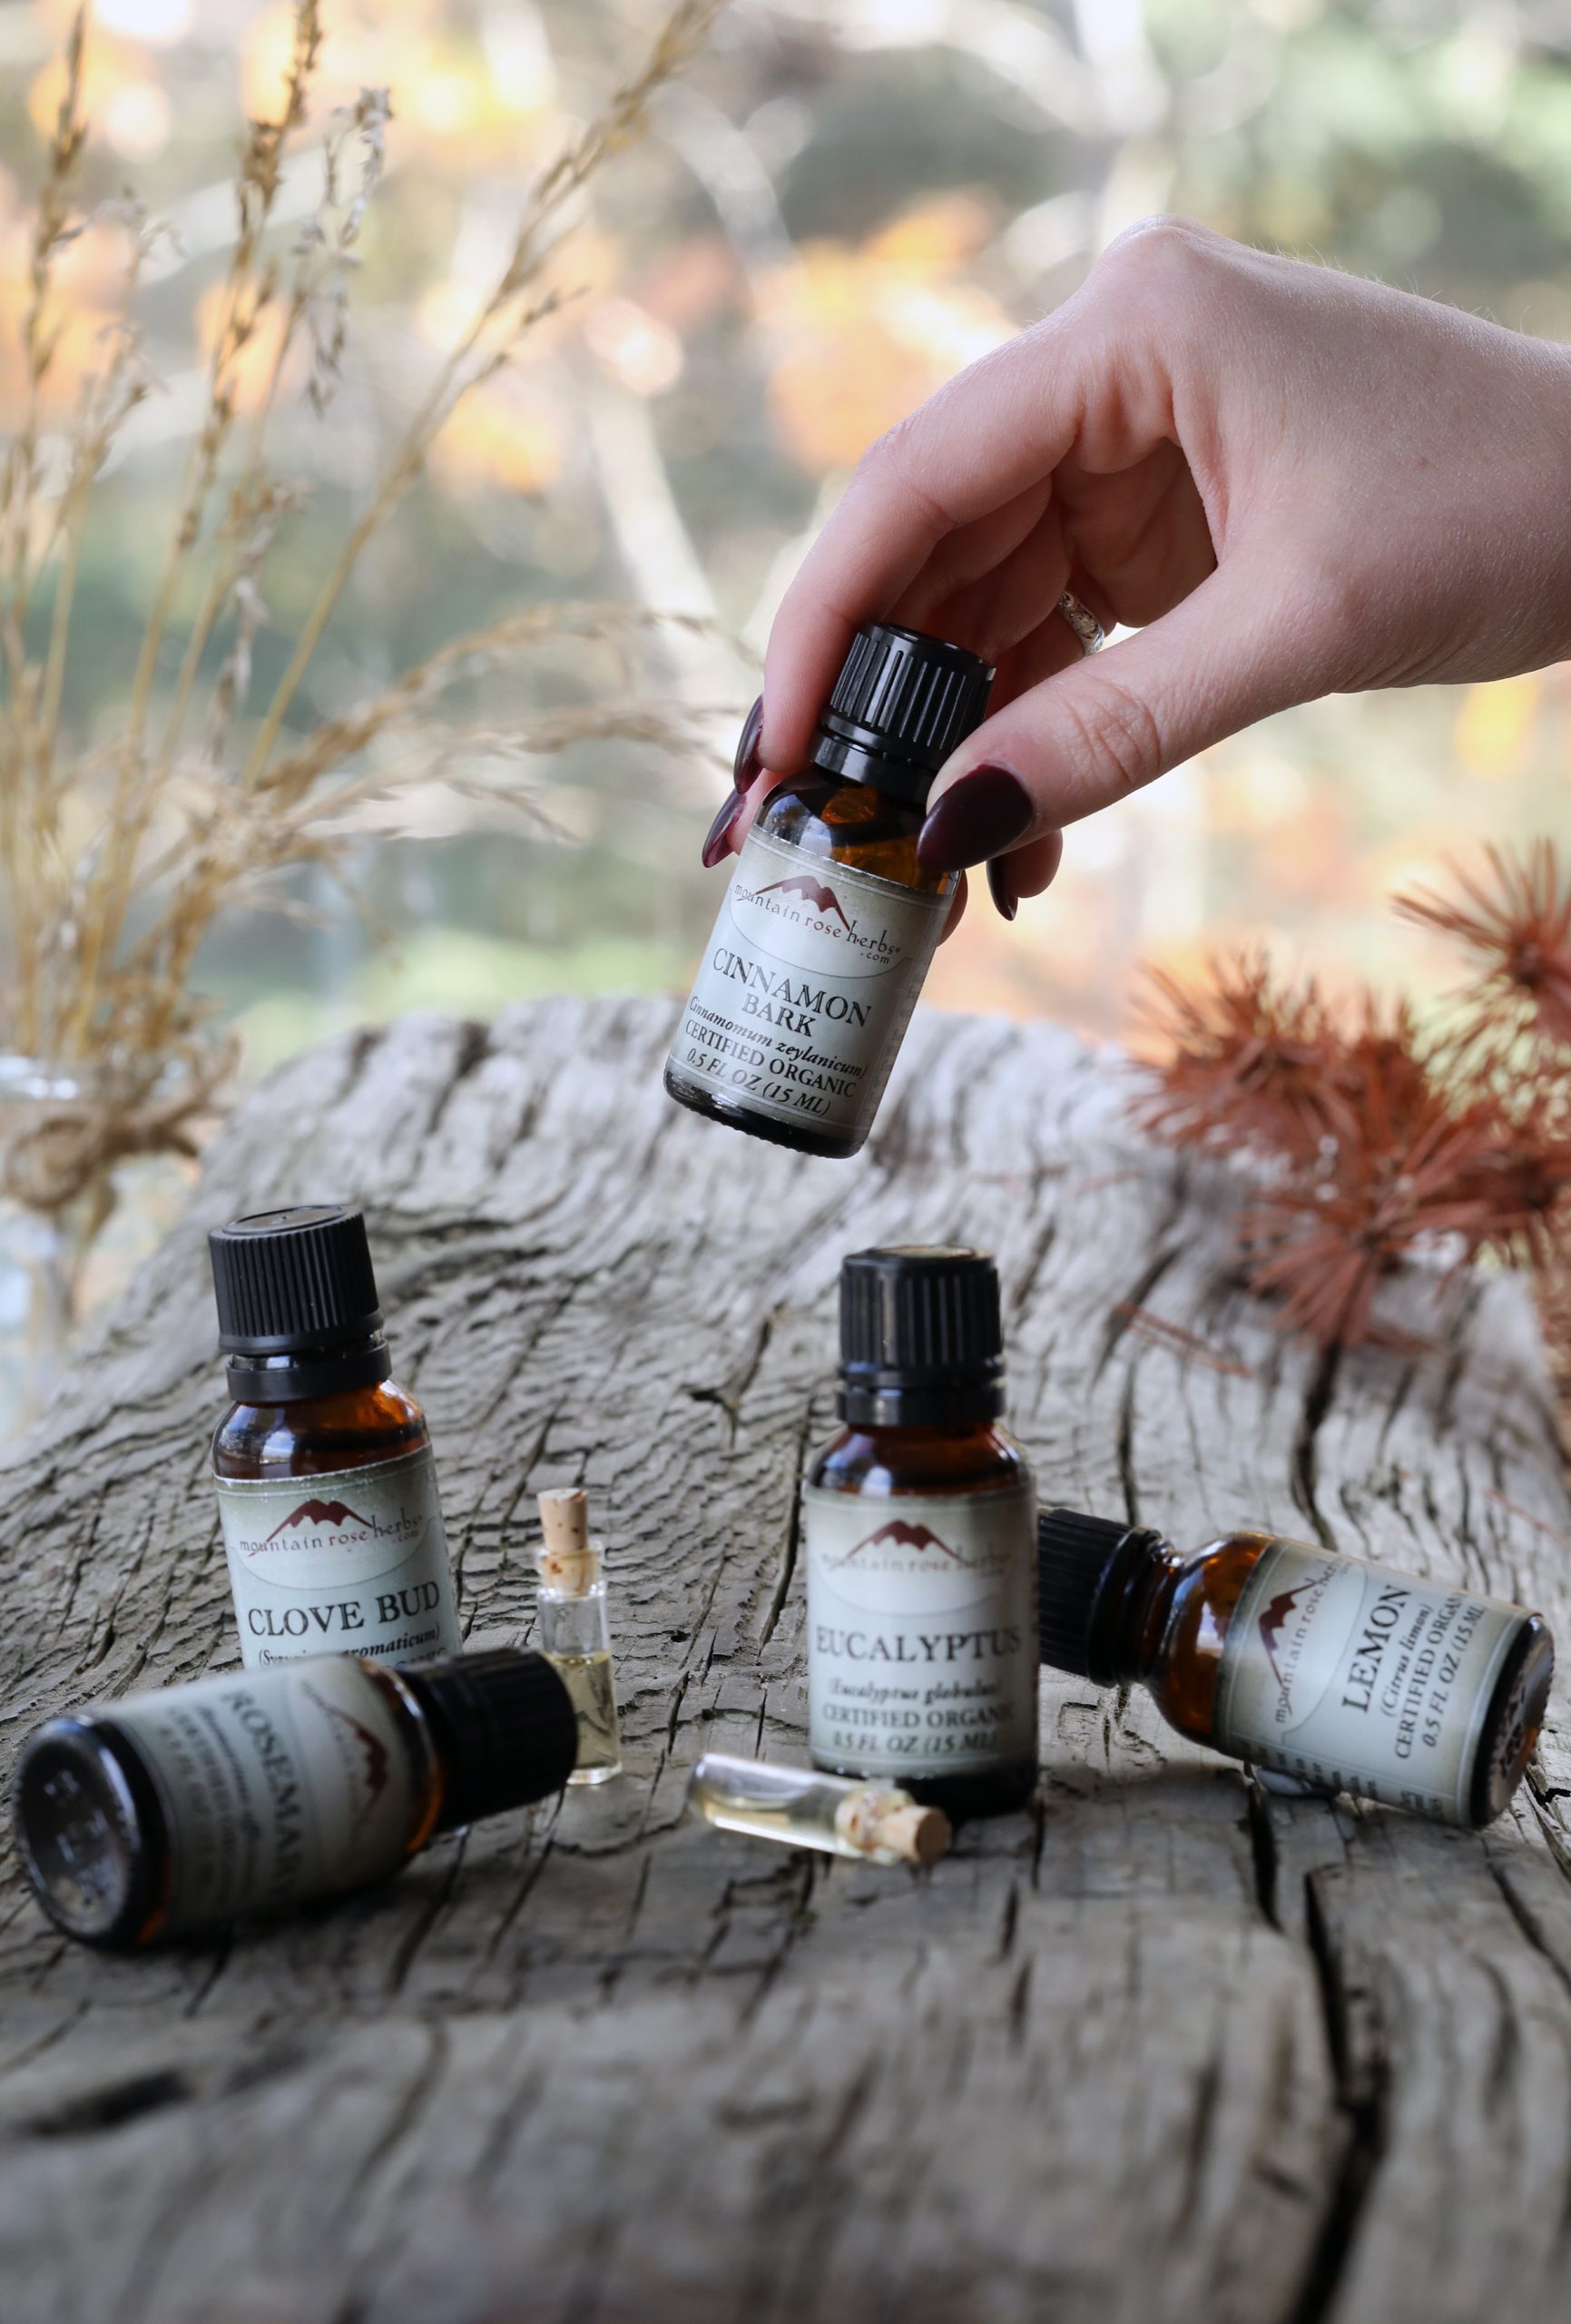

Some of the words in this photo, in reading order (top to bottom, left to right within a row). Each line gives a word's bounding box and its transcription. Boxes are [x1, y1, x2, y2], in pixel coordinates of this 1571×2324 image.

[734, 884, 800, 923] mountain
[805, 916, 841, 938] rose
[860, 951, 890, 965] .com
[712, 947, 871, 1028] CINNAMON
[689, 995, 772, 1048] (Cinnamomum
[775, 1040, 869, 1081] zeylanicum)
[741, 992, 817, 1038] BARK
[684, 1019, 765, 1068] CERTIFIED
[769, 1059, 857, 1098] ORGANIC
[686, 1048, 705, 1068] 0.5
[706, 1059, 728, 1078] FL
[731, 1068, 762, 1091] OZ
[762, 1081, 793, 1105] (15
[793, 1092, 831, 1117] ML)
[240, 1537, 322, 1558] mountain
[329, 1531, 368, 1547] rose
[248, 1600, 365, 1636] CLOVE
[375, 1580, 440, 1625] BUD
[815, 1624, 1022, 1663] EUCALYPTUS
[1274, 1627, 1308, 1724] mountain
[1301, 1589, 1325, 1624] rose
[1340, 1584, 1411, 1714] LEMON
[1380, 1654, 1411, 1718] (Citrus
[1399, 1602, 1435, 1651] limon)
[1453, 1625, 1474, 1652] (15
[1438, 1652, 1461, 1685] OZ
[822, 1701, 920, 1728] CERTIFIED
[1394, 1648, 1436, 1760] CERTIFIED
[1429, 1689, 1449, 1715] FL
[887, 1733, 918, 1754] OZ
[1421, 1717, 1442, 1748] 0.5
